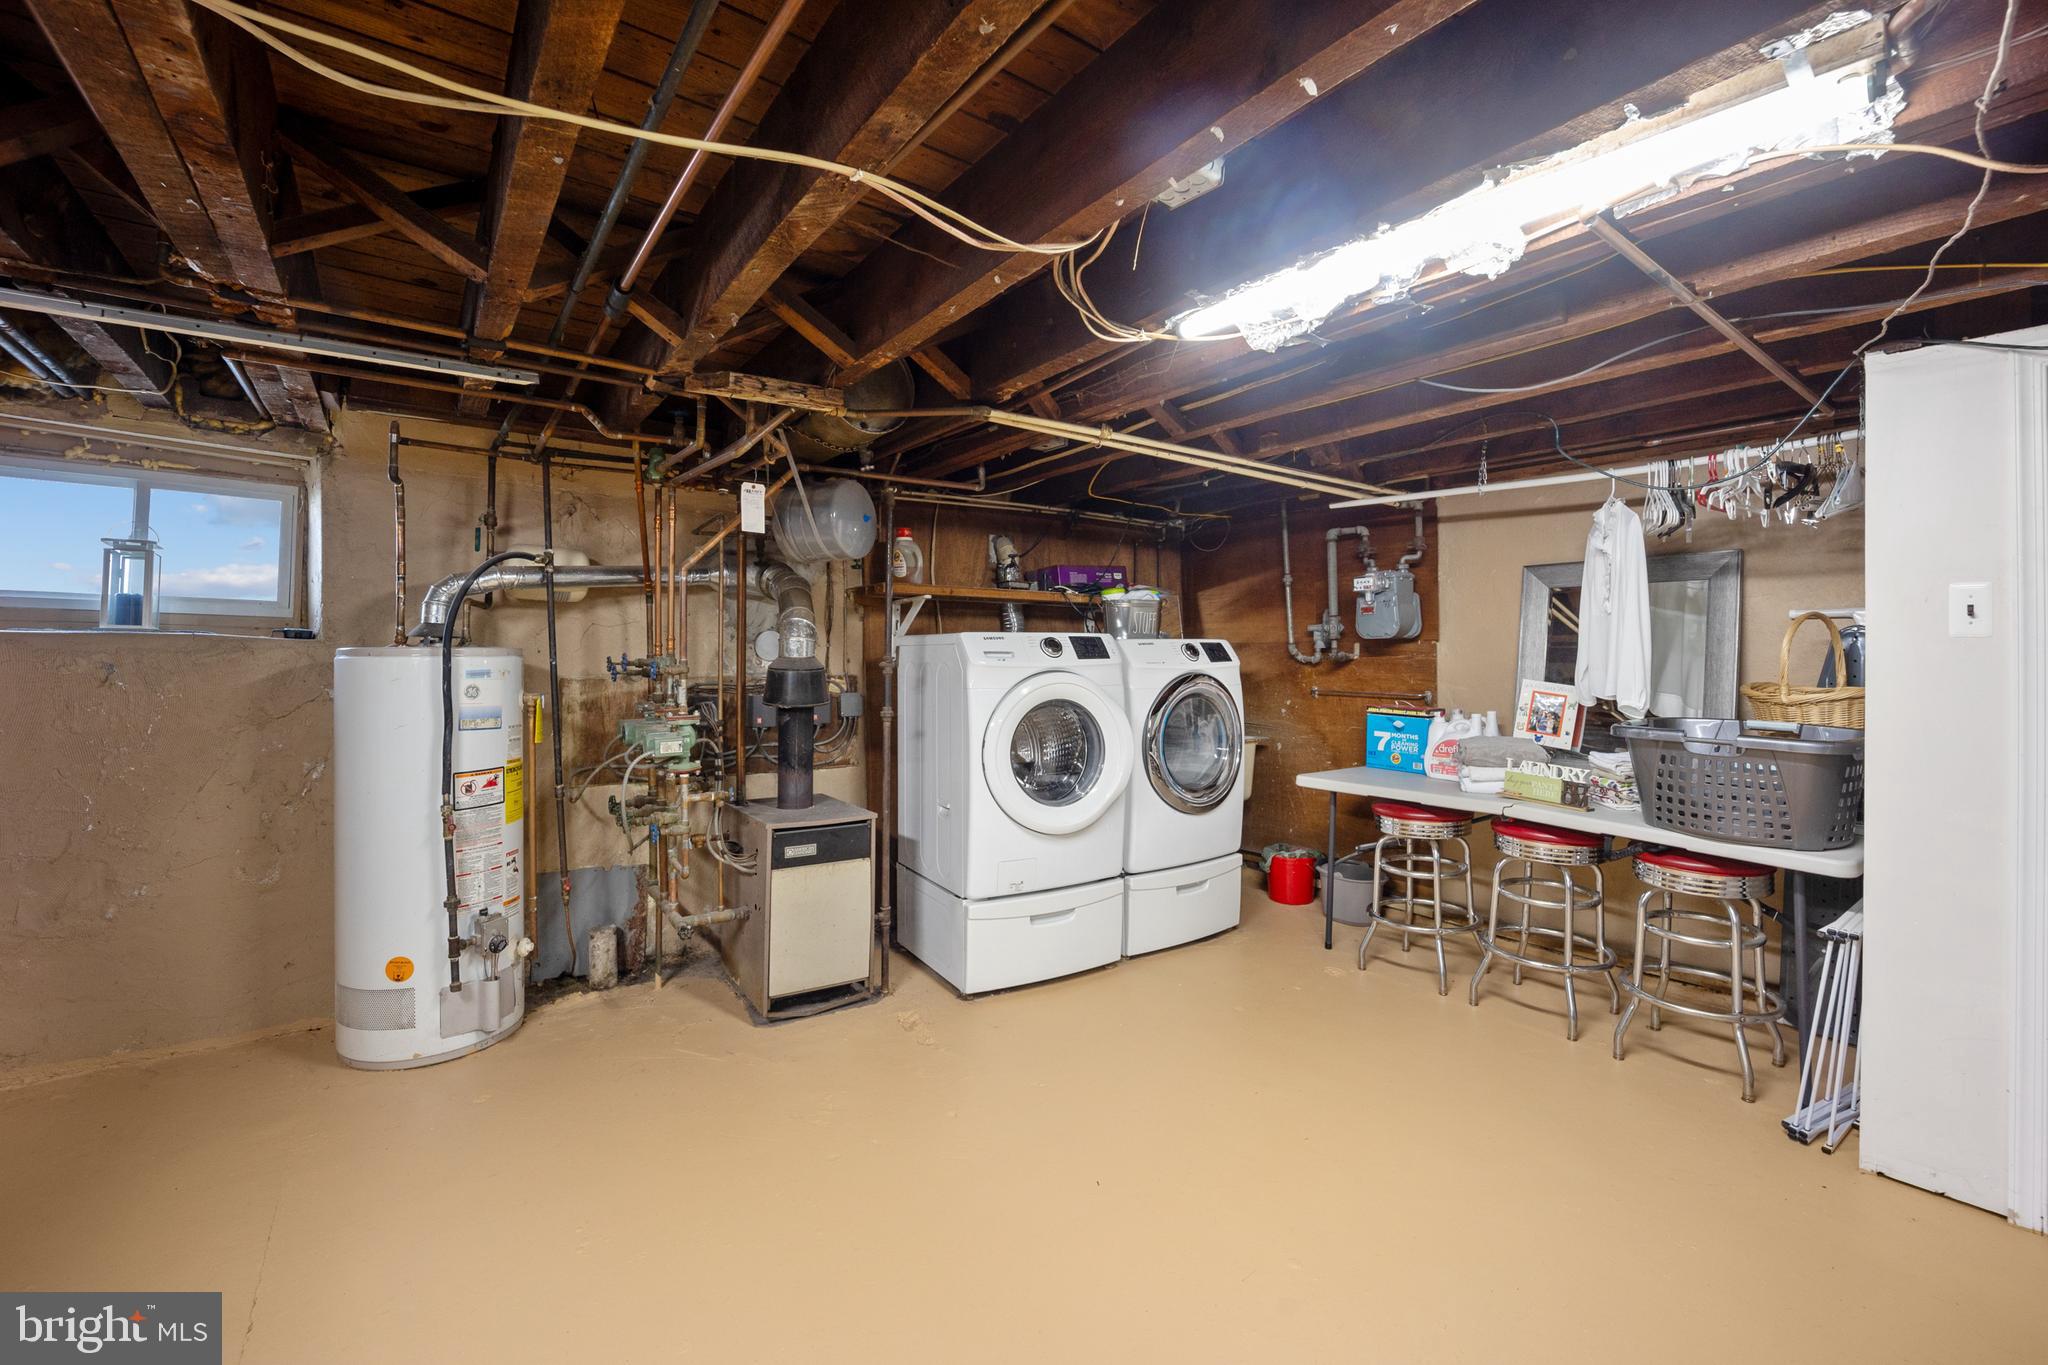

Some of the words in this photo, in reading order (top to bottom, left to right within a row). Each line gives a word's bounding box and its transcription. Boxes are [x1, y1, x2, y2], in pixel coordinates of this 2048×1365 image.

[1133, 612, 1157, 634] STUFF
[1374, 730, 1391, 751] 7
[1391, 732, 1419, 740] MONTHS
[1391, 745, 1419, 753] POWER
[1506, 757, 1591, 784] LAUNDRY
